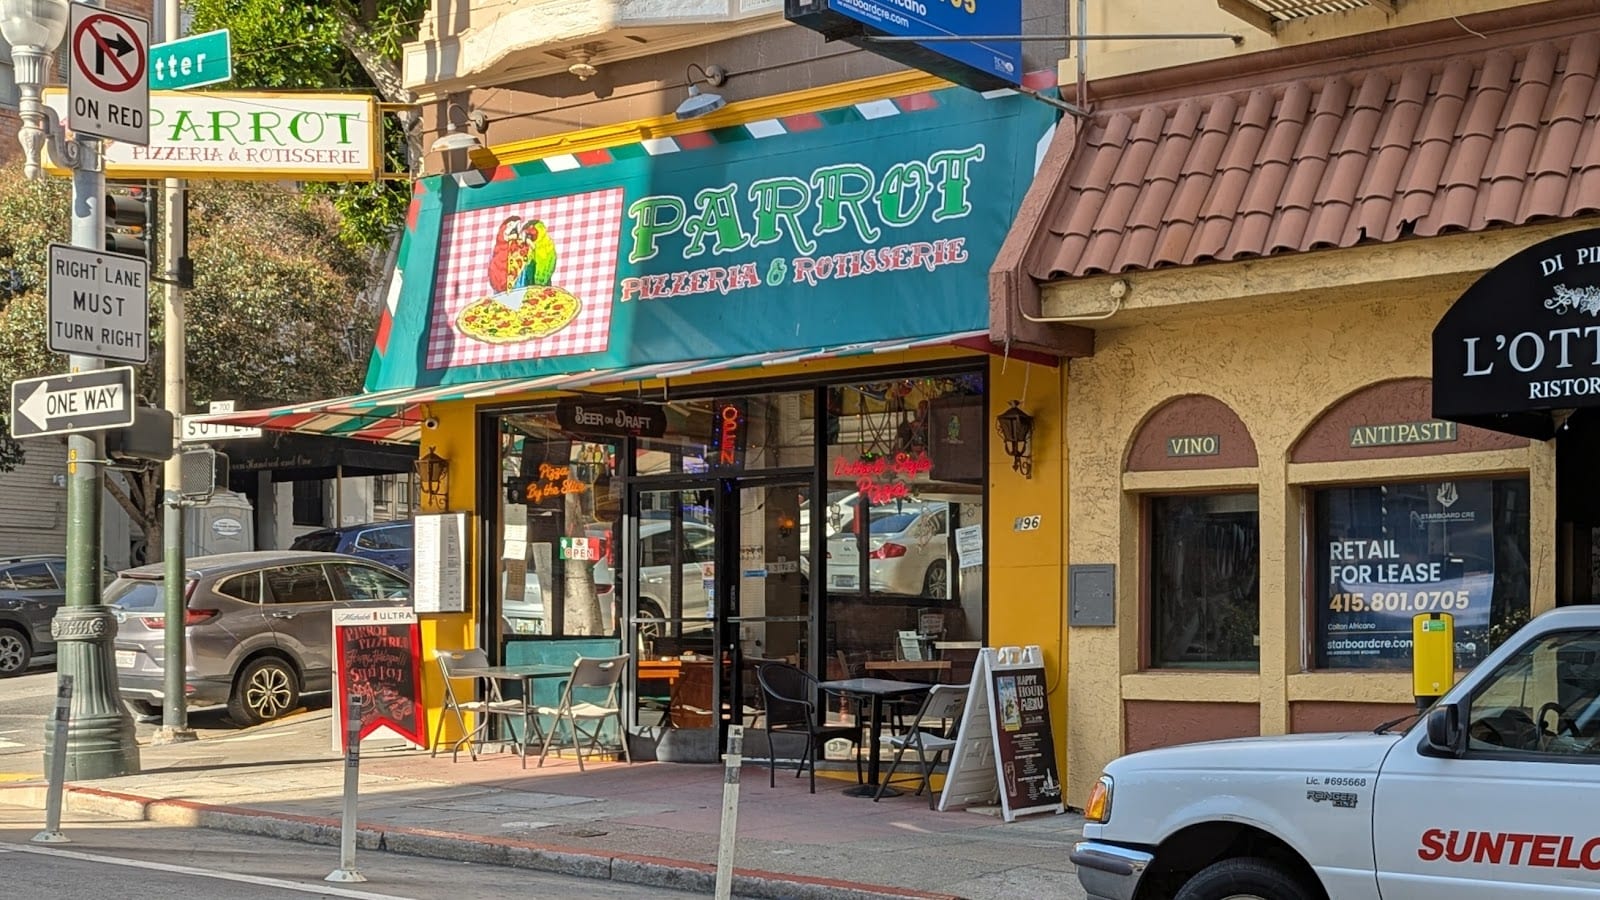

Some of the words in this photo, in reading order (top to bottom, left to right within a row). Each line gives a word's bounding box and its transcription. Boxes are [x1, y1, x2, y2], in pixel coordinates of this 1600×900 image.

[842, 0, 910, 28] boardcre.com
[154, 53, 207, 81] tter
[75, 96, 99, 120] ON
[108, 105, 143, 130] RED
[132, 145, 226, 163] PIZZERIA
[229, 147, 239, 162] &
[246, 147, 361, 164] ROTISSERIE
[629, 143, 985, 264] PARROT
[56, 258, 98, 280] RIGHT
[105, 268, 142, 288] LANE
[620, 262, 761, 302] PIZZERIA
[766, 257, 787, 286] &
[792, 237, 968, 286] ROTISSERIE
[1540, 254, 1565, 277] DI
[73, 290, 125, 317] MUST
[55, 321, 94, 342] TURN
[101, 329, 143, 349] RIGHT
[1528, 377, 1600, 399] RISTOR
[46, 393, 76, 415] ONE
[84, 387, 120, 412] WAY
[188, 421, 255, 436] SUTT
[575, 406, 604, 427] BEER
[615, 409, 652, 429] DRAFT
[1352, 421, 1452, 446] ANTIPASTI
[1171, 437, 1216, 454] VINO
[539, 463, 570, 481] Pizza
[1014, 516, 1041, 530] 96
[564, 547, 594, 560] OPEN
[1330, 540, 1400, 560] RETAIL
[1330, 565, 1372, 584] FOR
[1377, 562, 1441, 582] LEASE
[1329, 591, 1469, 612] 415.801.0705
[380, 611, 413, 620] ULTRA
[1018, 685, 1045, 698] HOUR
[1306, 776, 1320, 785] Lic.
[1324, 777, 1367, 787] #695668
[1306, 790, 1359, 803] RANGER
